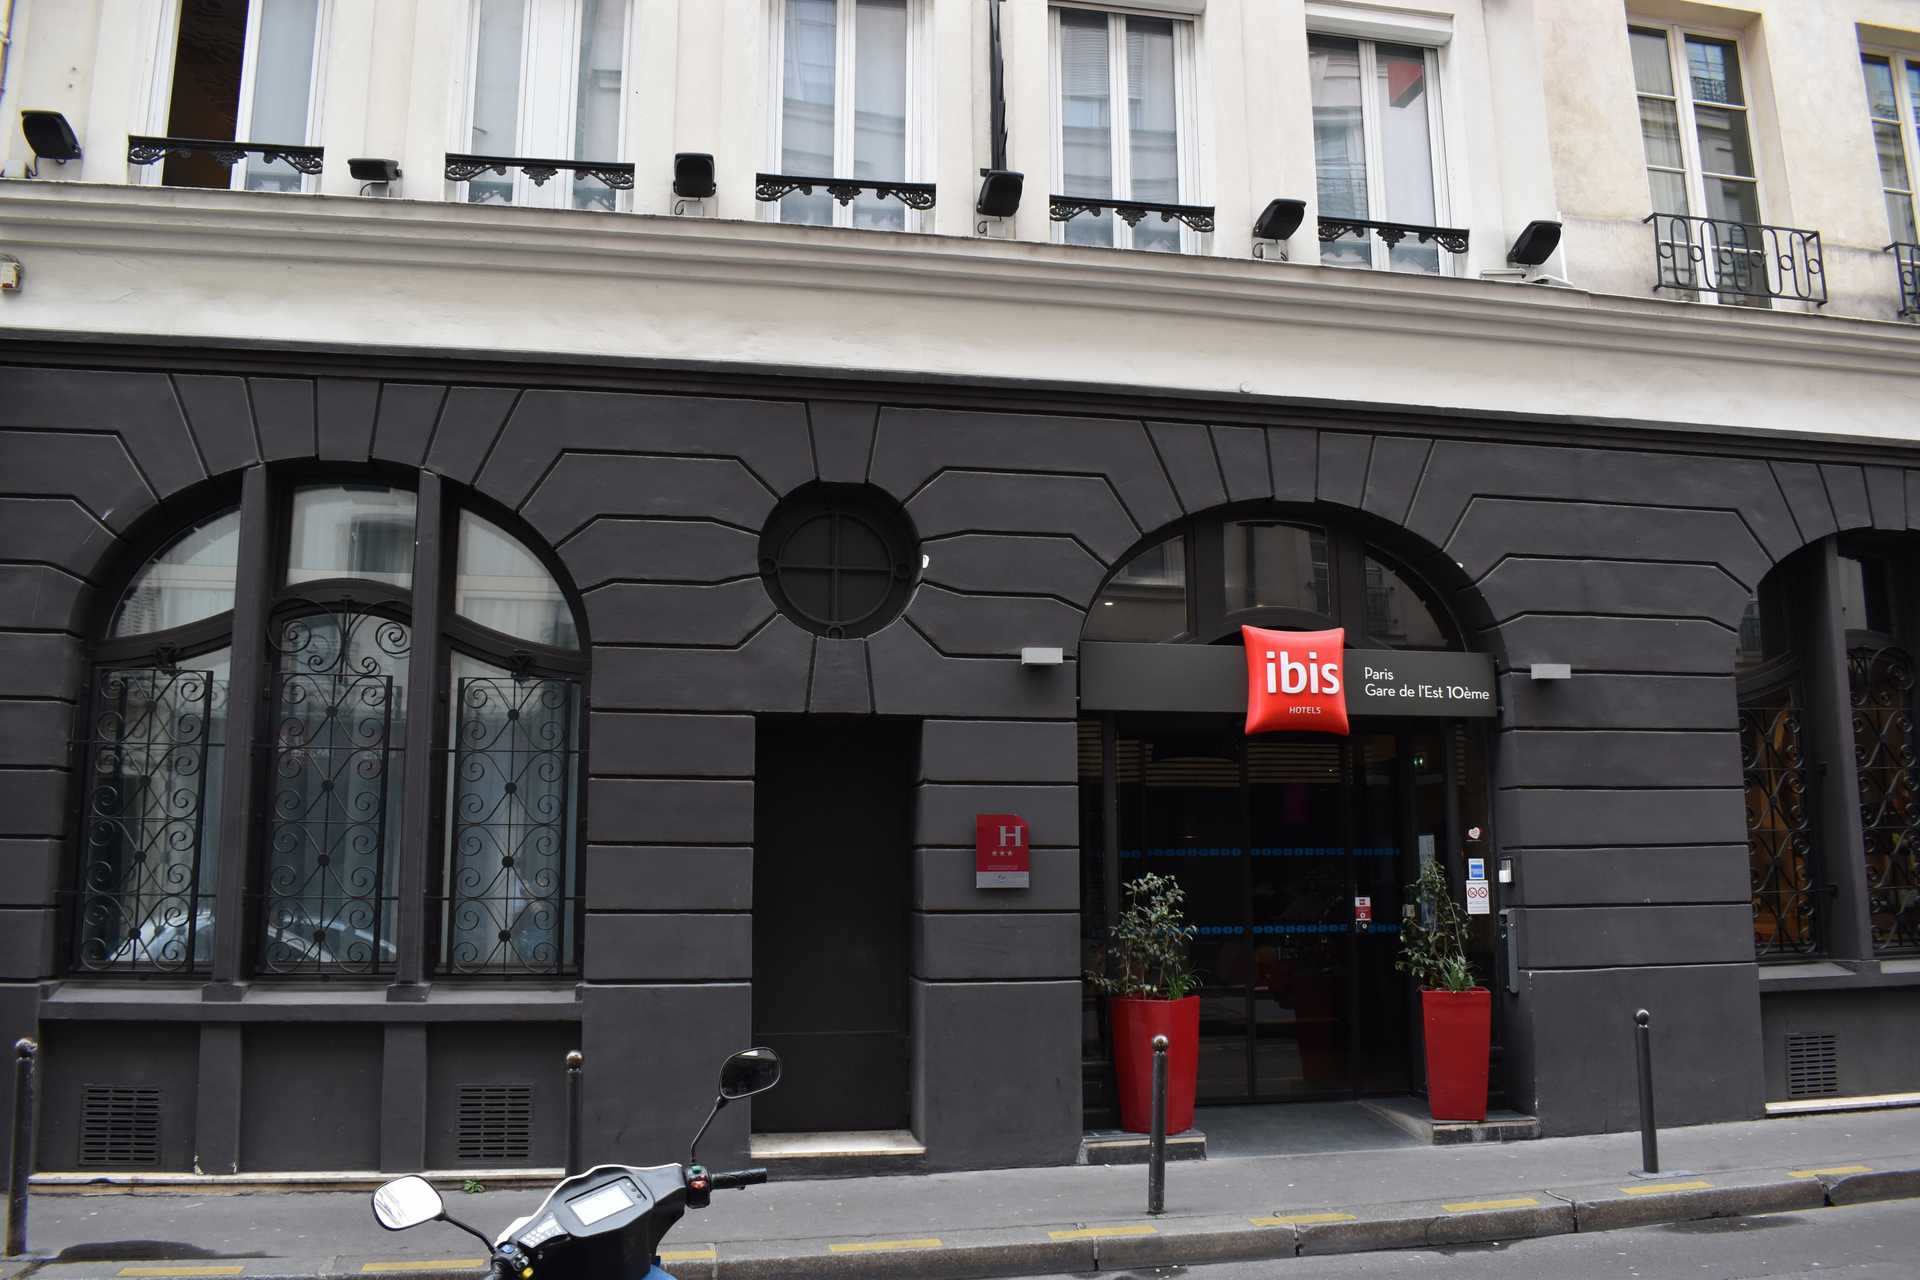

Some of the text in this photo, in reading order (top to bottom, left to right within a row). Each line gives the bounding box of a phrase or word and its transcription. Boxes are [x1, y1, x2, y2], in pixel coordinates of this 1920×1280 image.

[1266, 651, 1340, 694] ibis
[1364, 667, 1394, 680] Paris
[1365, 683, 1490, 700] Gare de l'Est 10ème
[1289, 706, 1321, 715] HOTELS
[999, 825, 1023, 847] H
